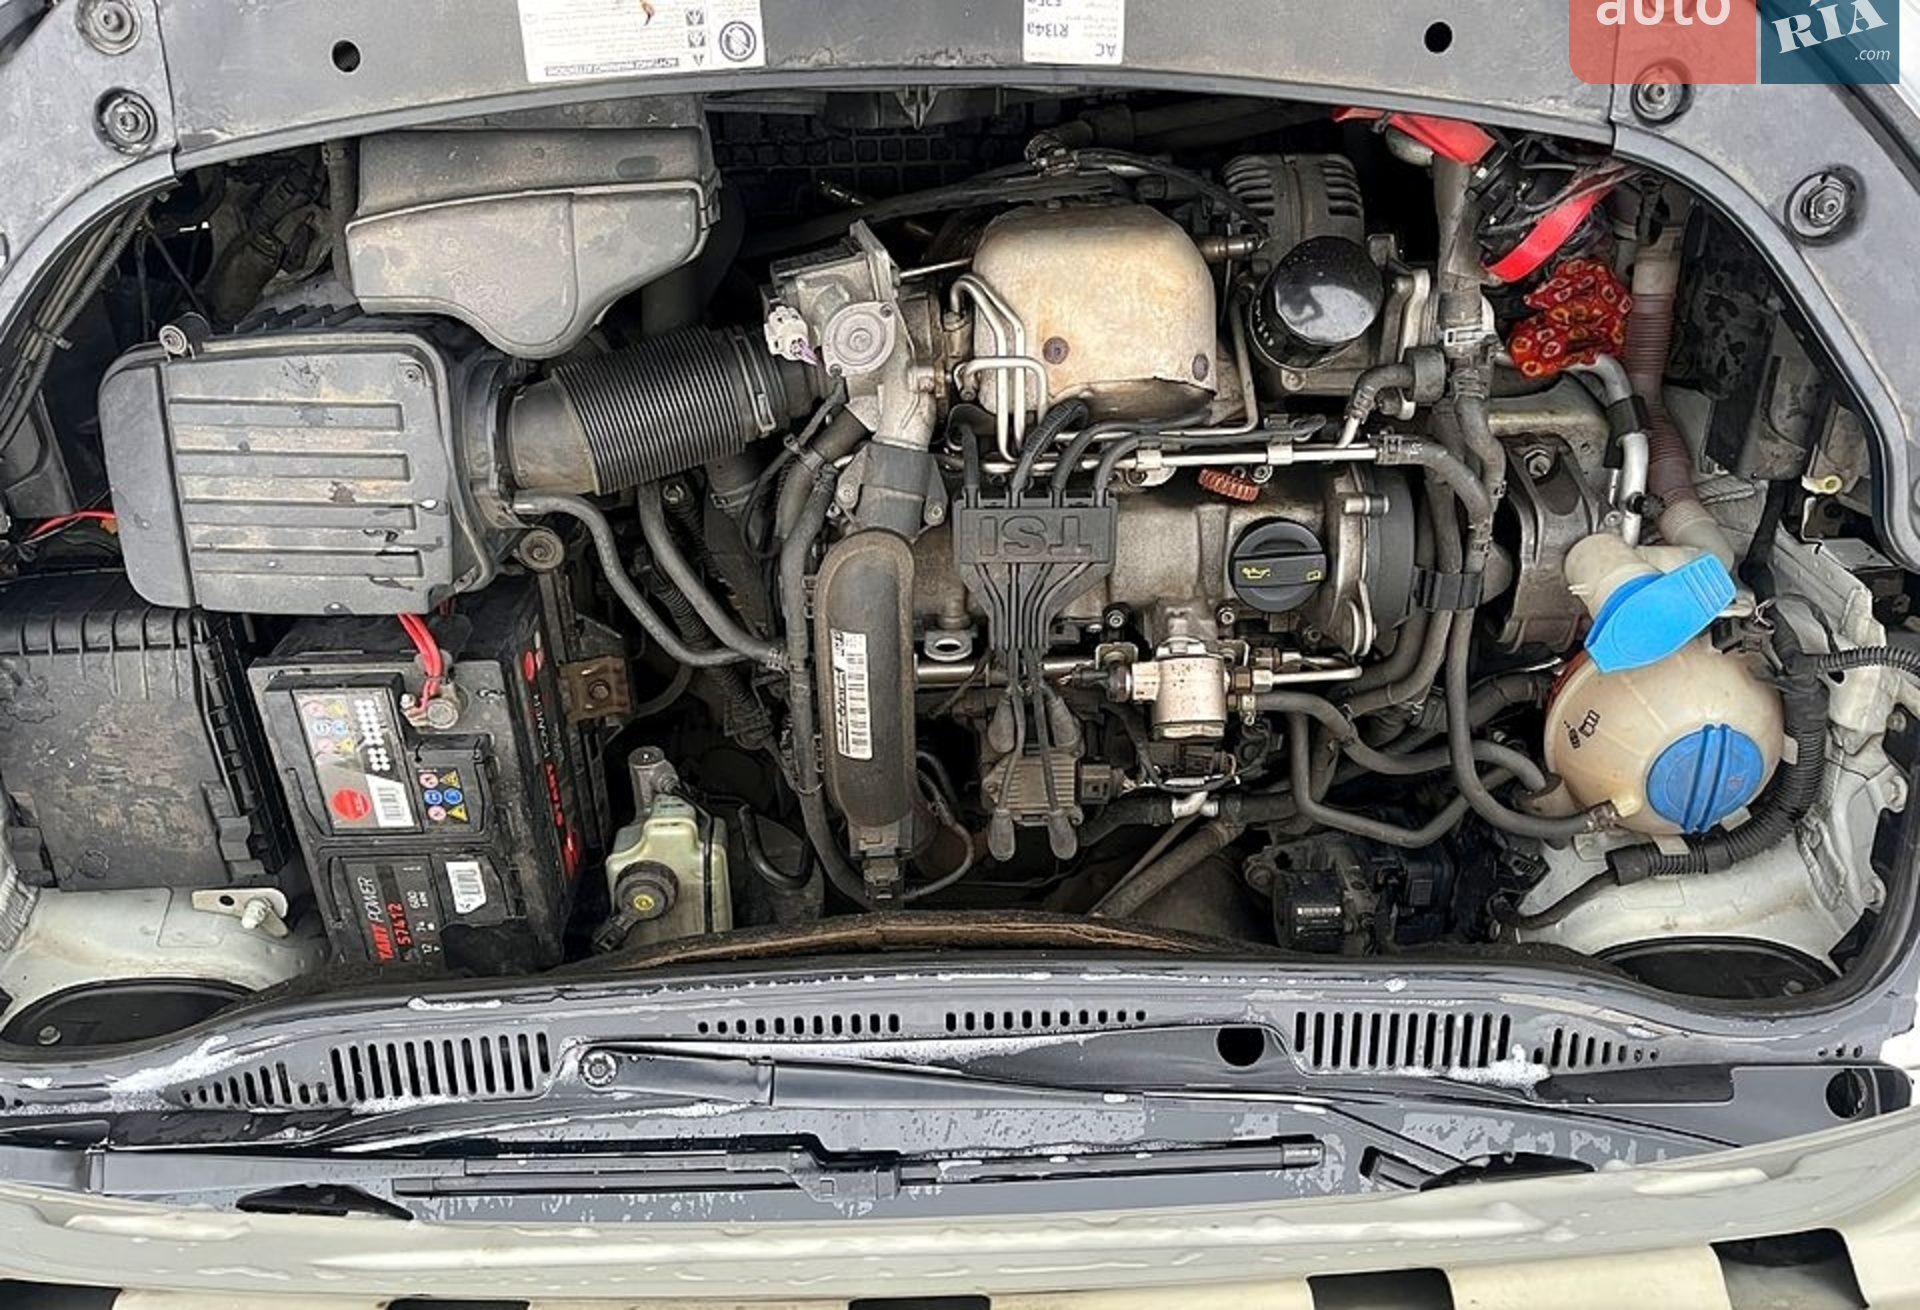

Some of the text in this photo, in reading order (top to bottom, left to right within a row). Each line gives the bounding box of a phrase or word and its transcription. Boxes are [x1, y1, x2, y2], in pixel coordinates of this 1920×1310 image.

[1027, 22, 1069, 39] R134a
[1095, 43, 1117, 57] AC
[980, 516, 1092, 556] TSI
[358, 876, 394, 961] TART POWER
[387, 902, 411, 945] 57412
